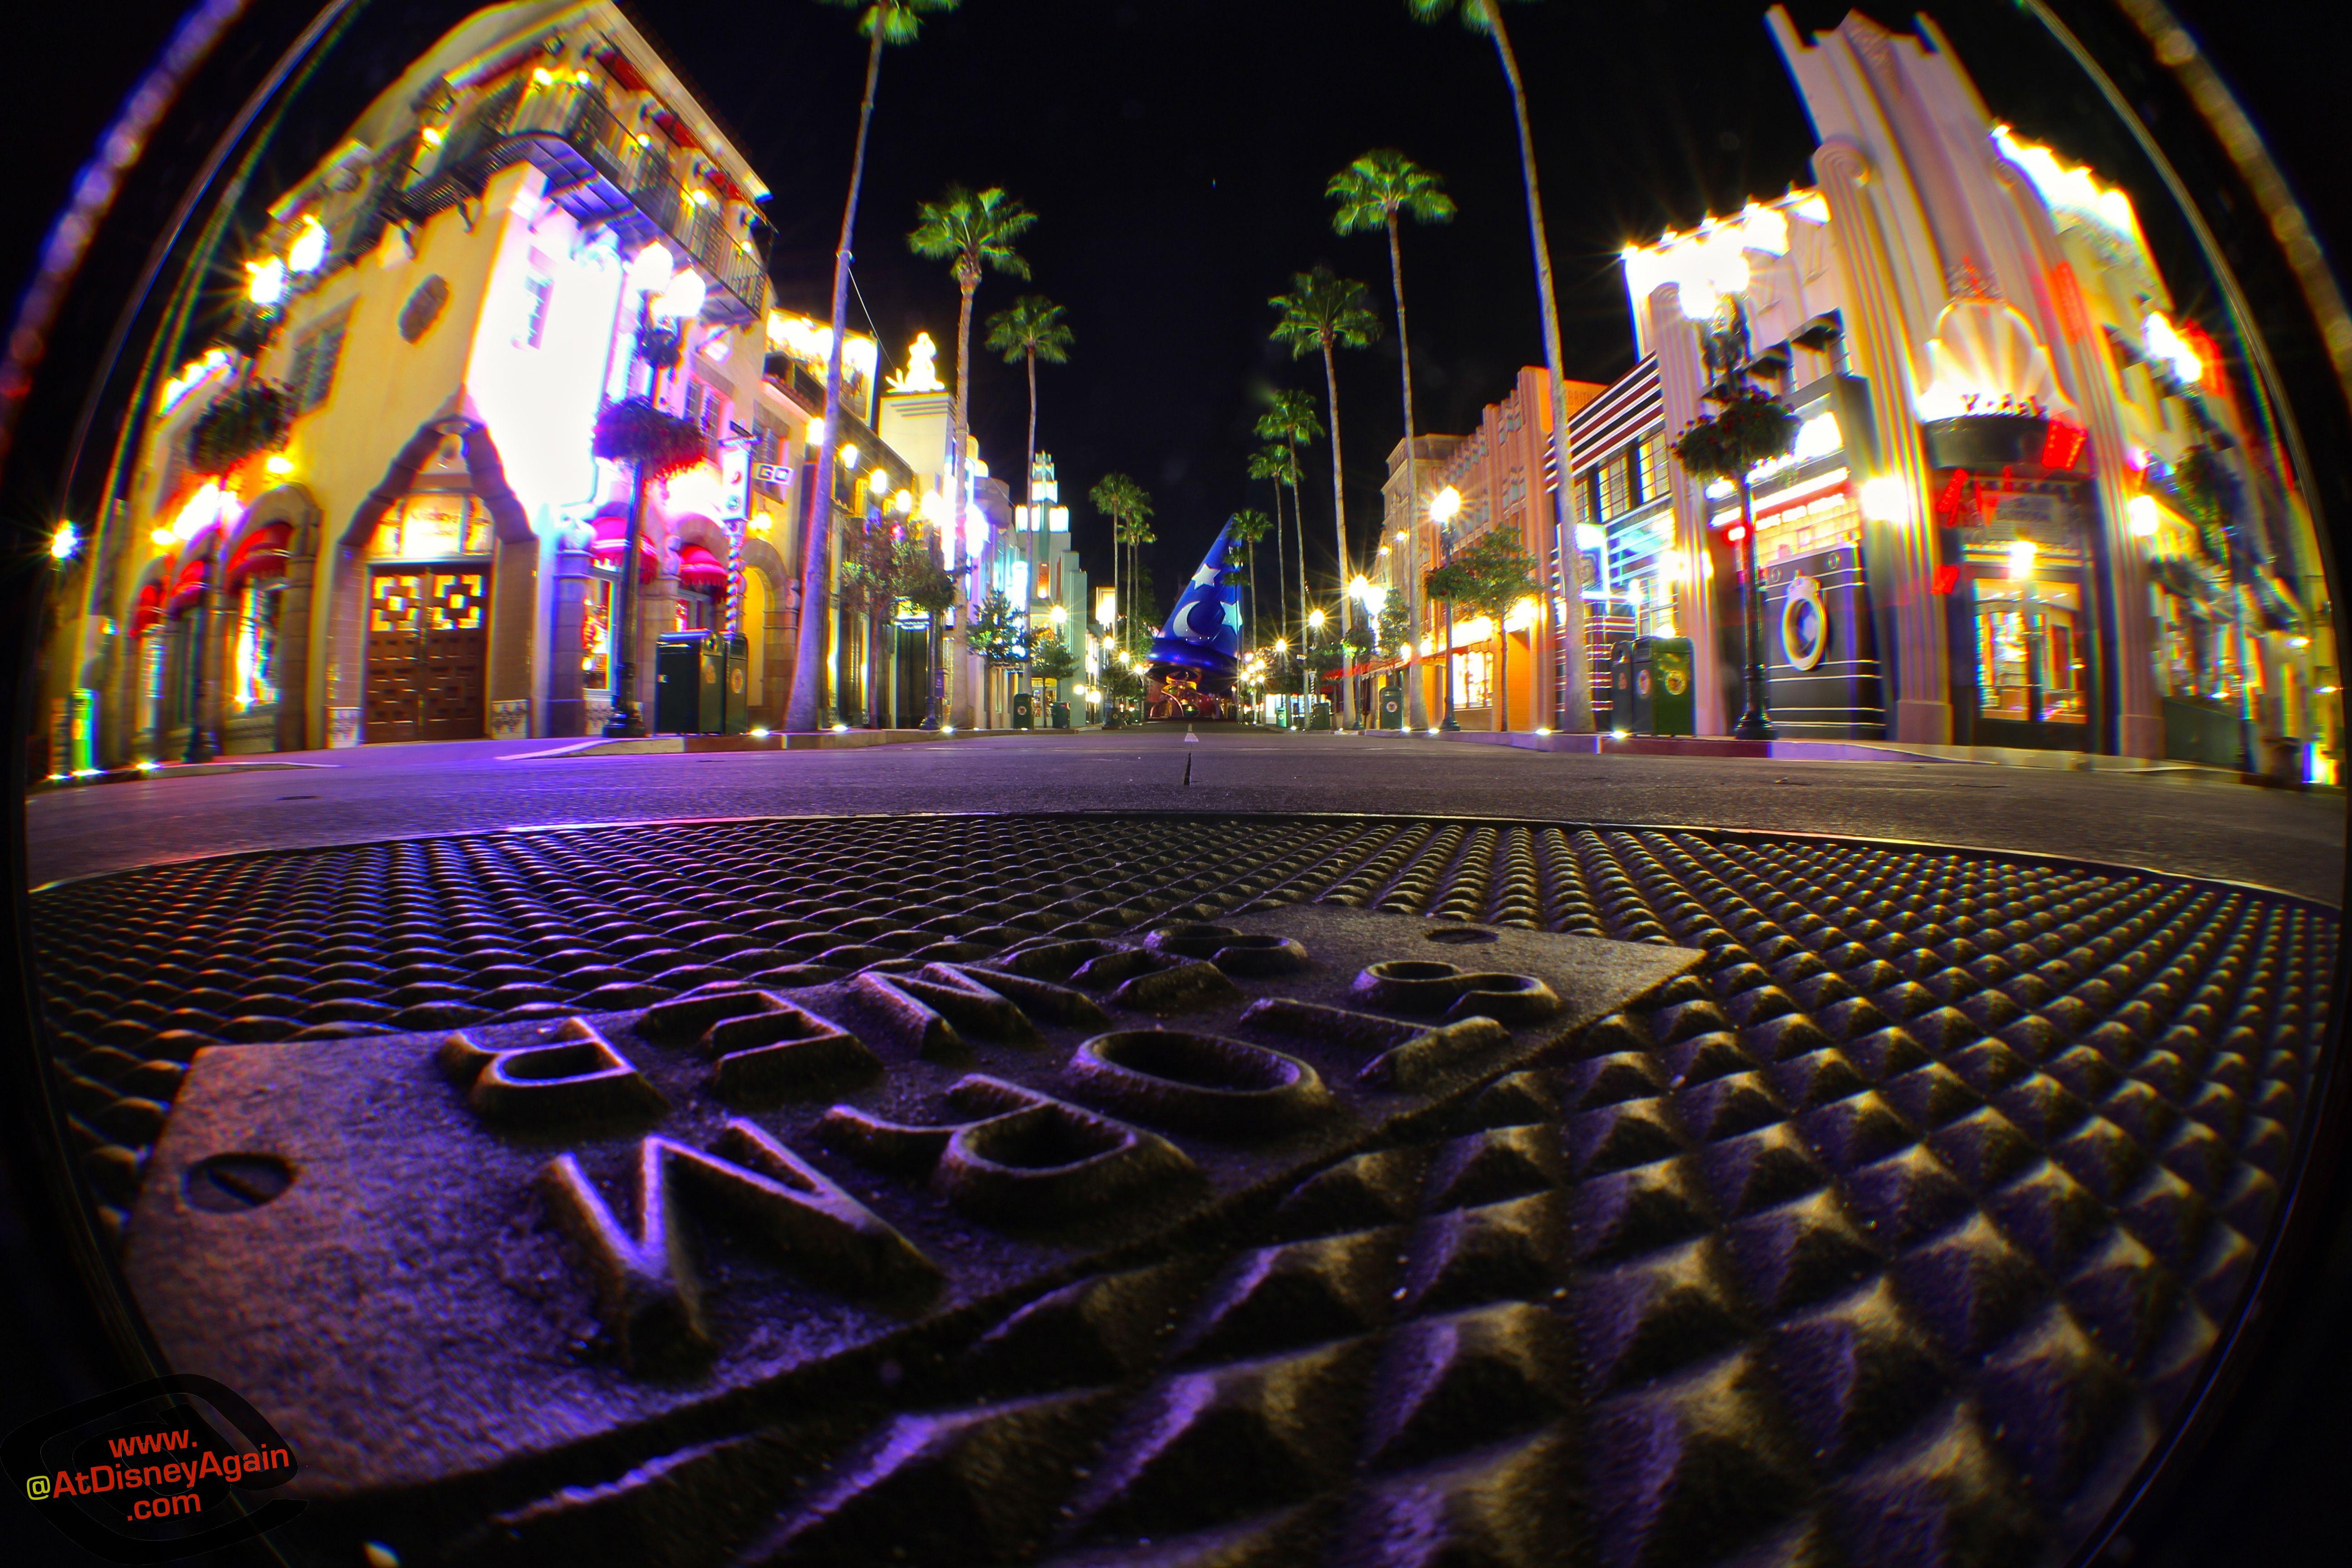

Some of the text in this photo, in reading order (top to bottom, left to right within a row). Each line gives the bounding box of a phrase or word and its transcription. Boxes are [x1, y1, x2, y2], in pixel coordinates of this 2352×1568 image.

[758, 465, 789, 482] GO
[440, 924, 1309, 1125] SEWER
[538, 958, 1561, 1375] STORM
